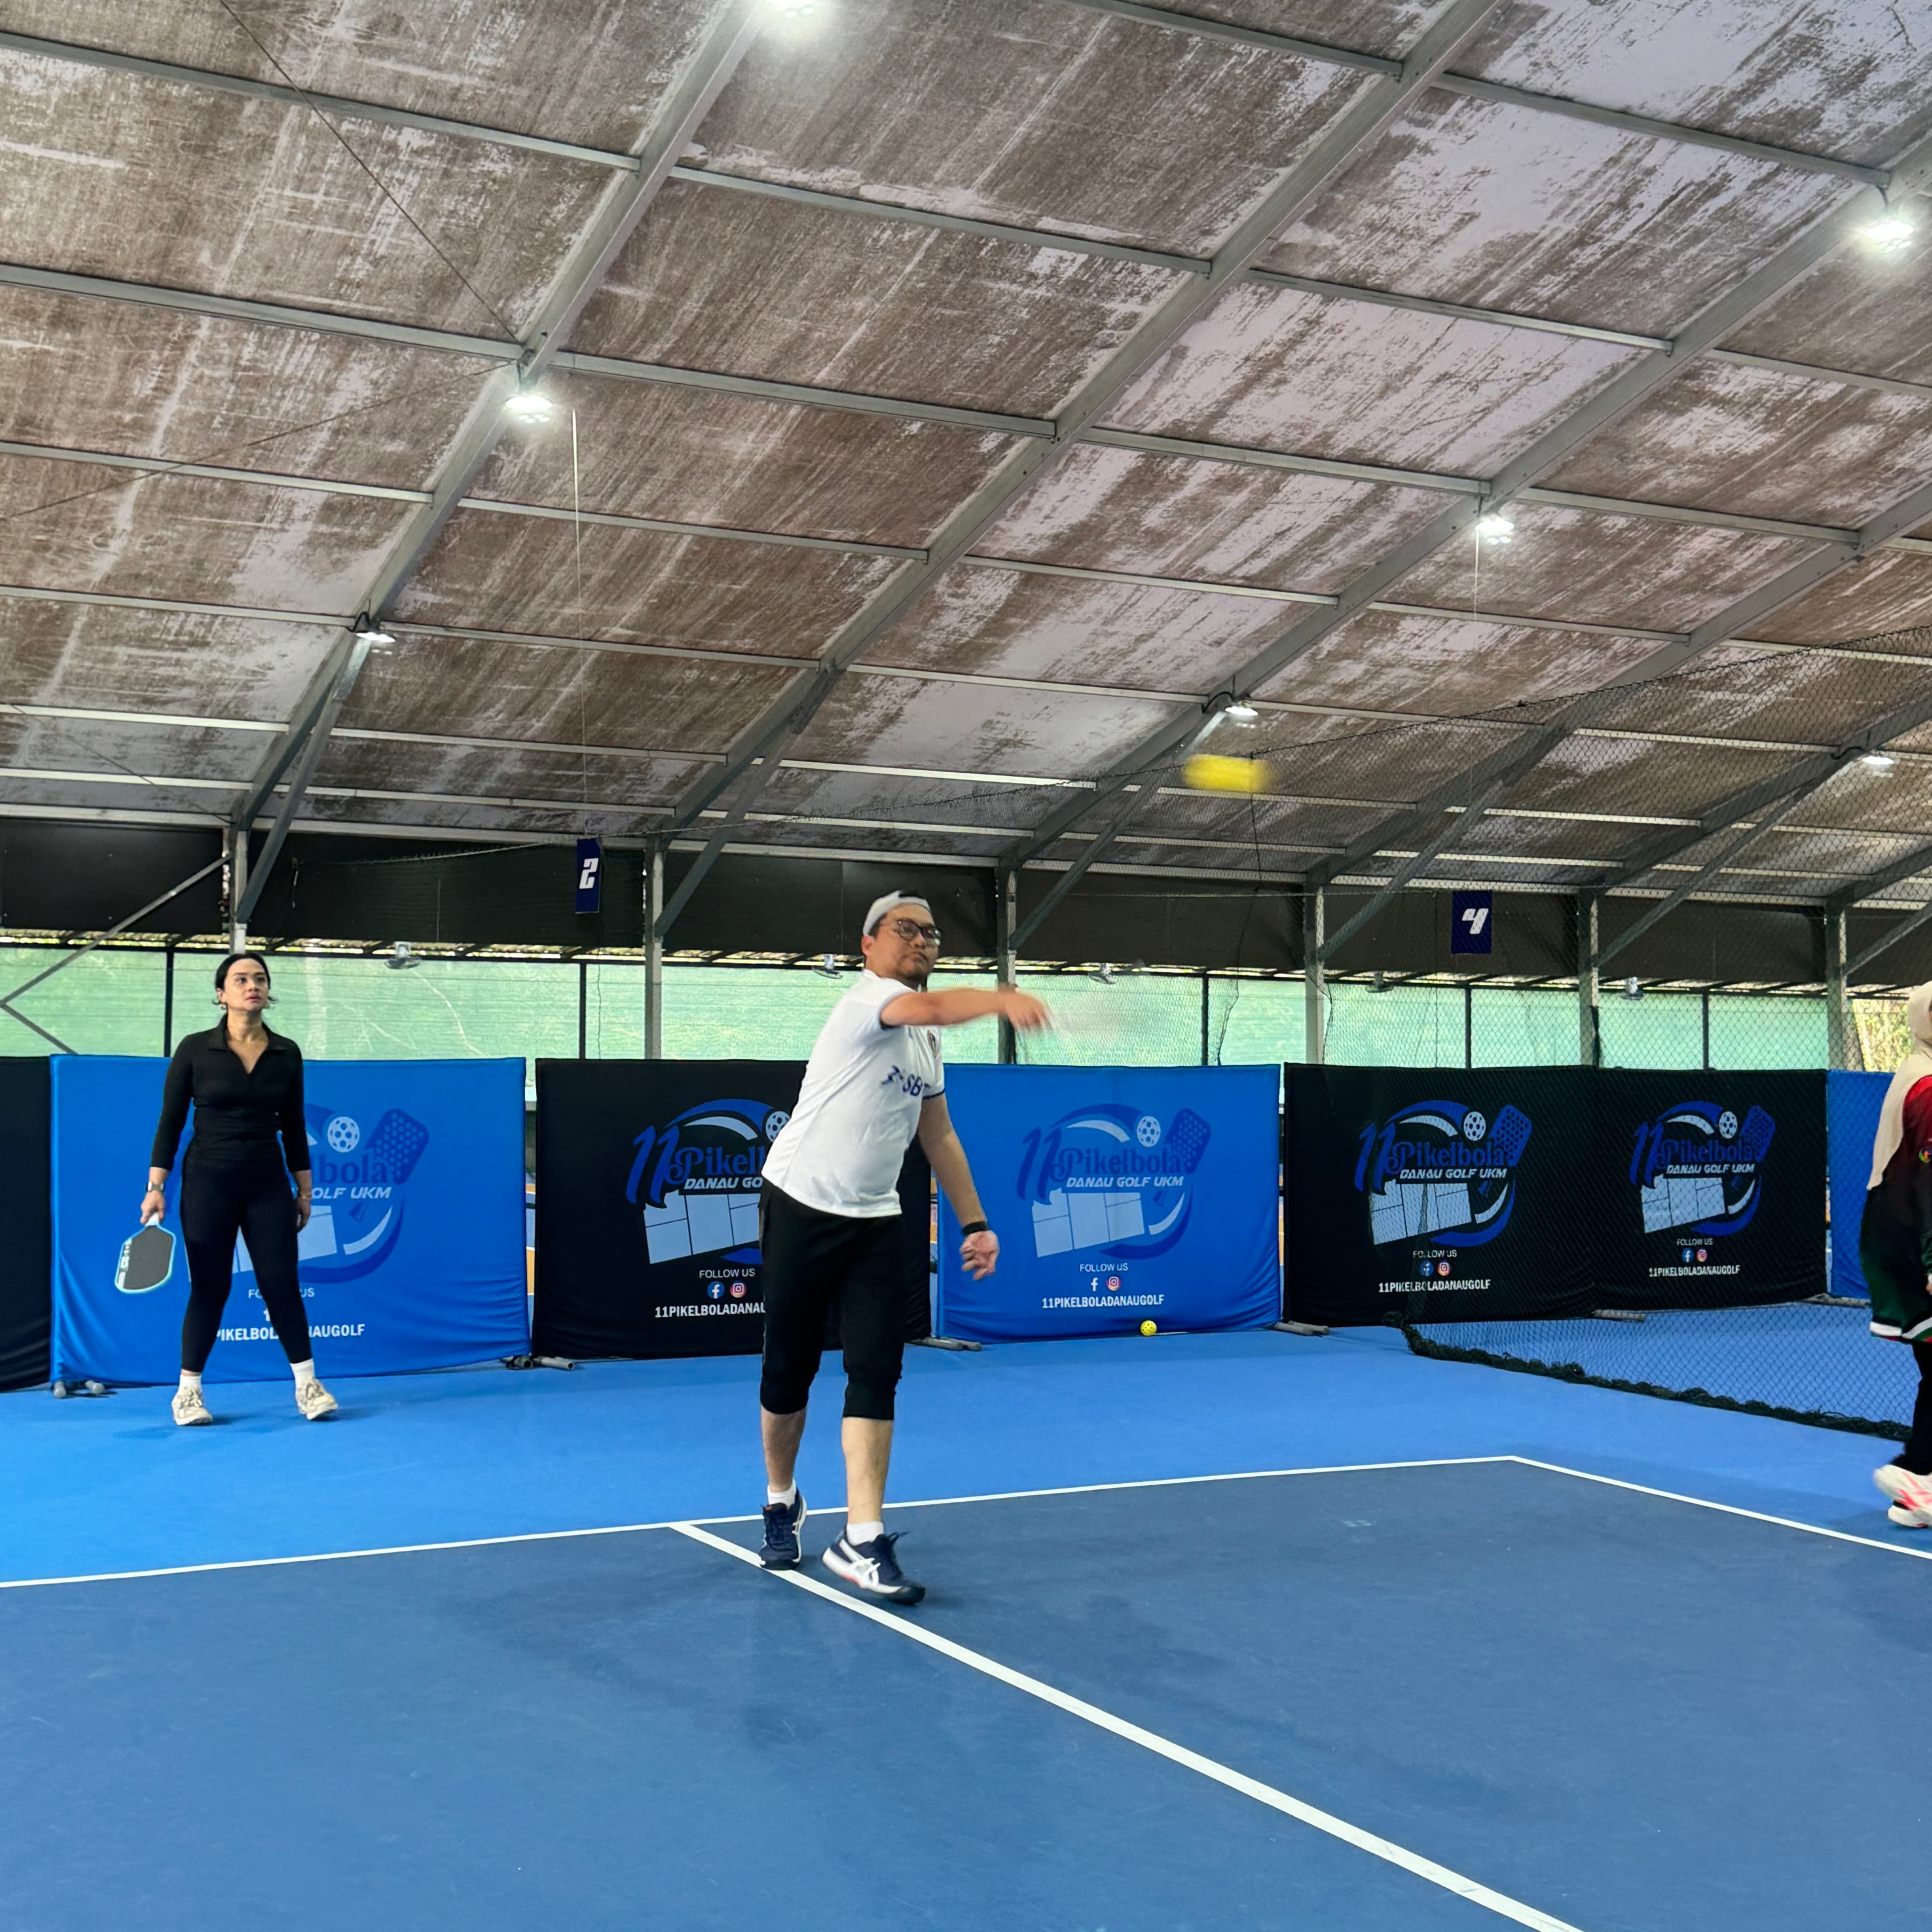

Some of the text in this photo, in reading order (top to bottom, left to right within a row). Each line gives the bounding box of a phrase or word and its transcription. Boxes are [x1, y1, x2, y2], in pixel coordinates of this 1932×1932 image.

[579, 858, 599, 889] 2
[1462, 908, 1489, 934] 4
[1049, 1147, 1181, 1182] Pikelbola
[1384, 1141, 1505, 1175] Pikelbola
[1399, 1168, 1507, 1179] DANAU GOLF UKM
[1666, 1163, 1755, 1174] DANAU GOLF UKM
[684, 1176, 763, 1190] DANAU GO
[1066, 1176, 1184, 1188] DANAU GOLF UKM
[311, 1186, 392, 1199] OLF UKM
[1676, 1238, 1714, 1246] FOLLOW US
[699, 1268, 755, 1278] FOLLOW US
[1079, 1263, 1129, 1272] FOLLOW US
[1042, 1294, 1165, 1309] 11PIKELBOLADANAUGOLF
